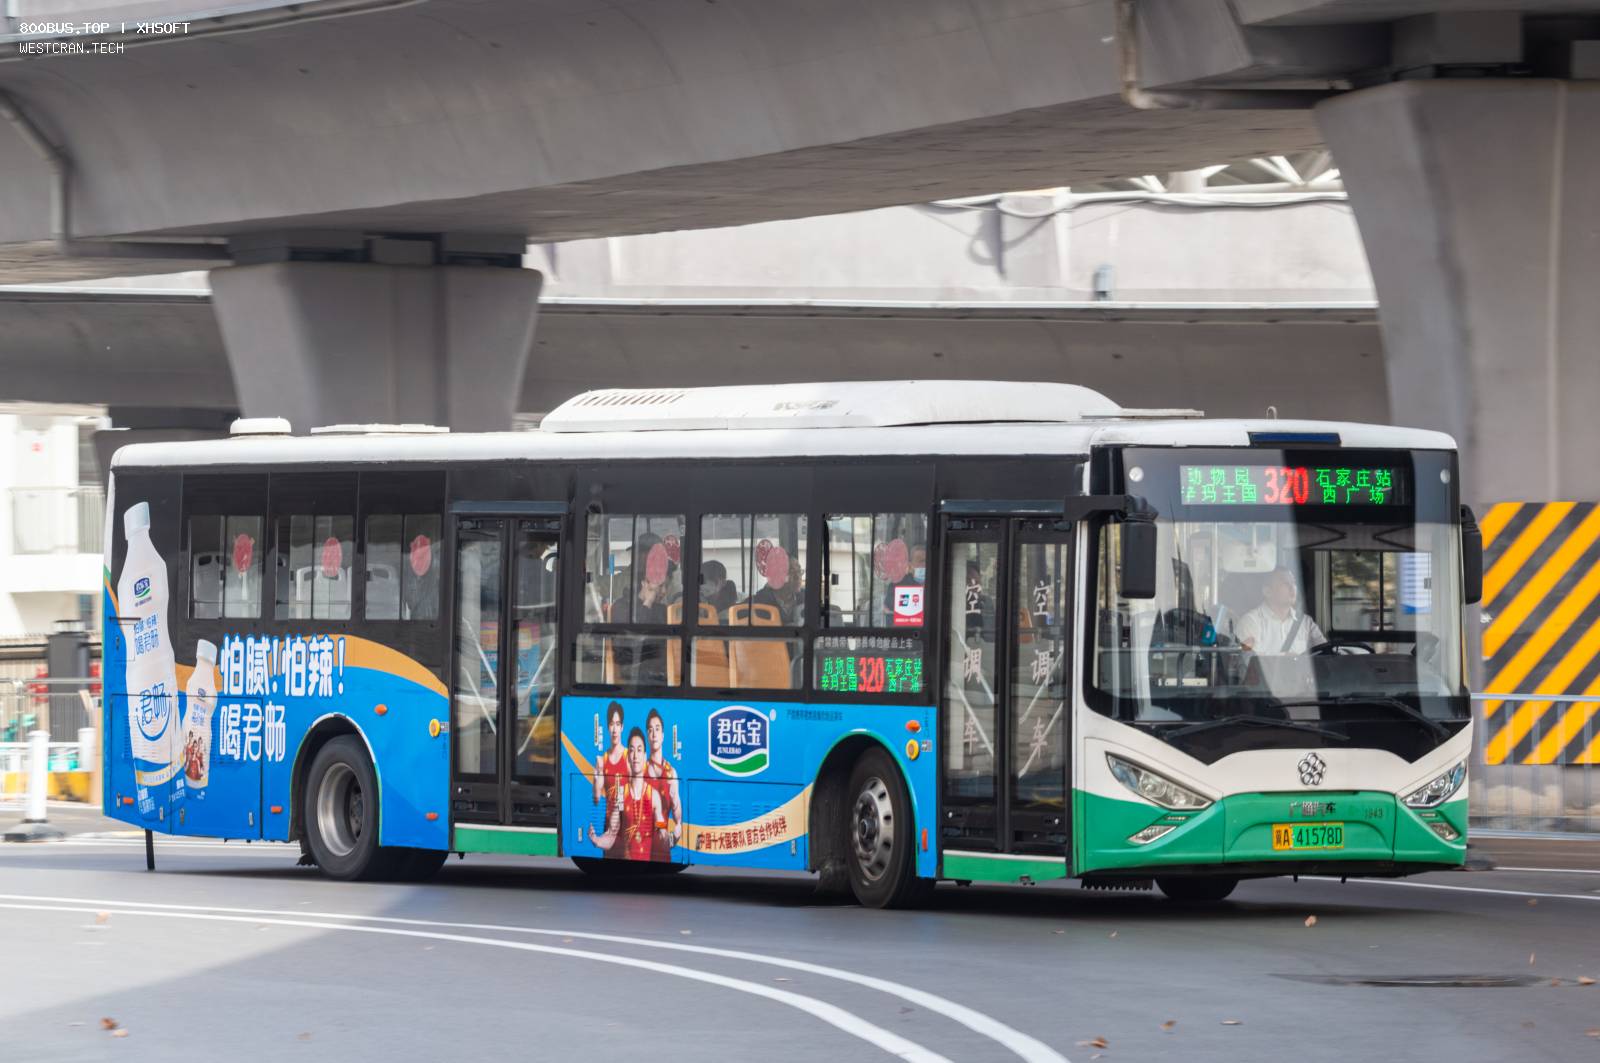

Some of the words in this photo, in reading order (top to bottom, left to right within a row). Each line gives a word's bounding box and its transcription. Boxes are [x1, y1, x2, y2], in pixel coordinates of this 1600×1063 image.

[1187, 467, 1250, 487] 动物园
[1263, 466, 1309, 504] 320
[1315, 468, 1393, 488] 石家庄站
[1322, 485, 1386, 504] 西广场
[858, 657, 884, 692] 320
[219, 700, 286, 762] 喝君畅
[716, 718, 762, 746] 君乐宝
